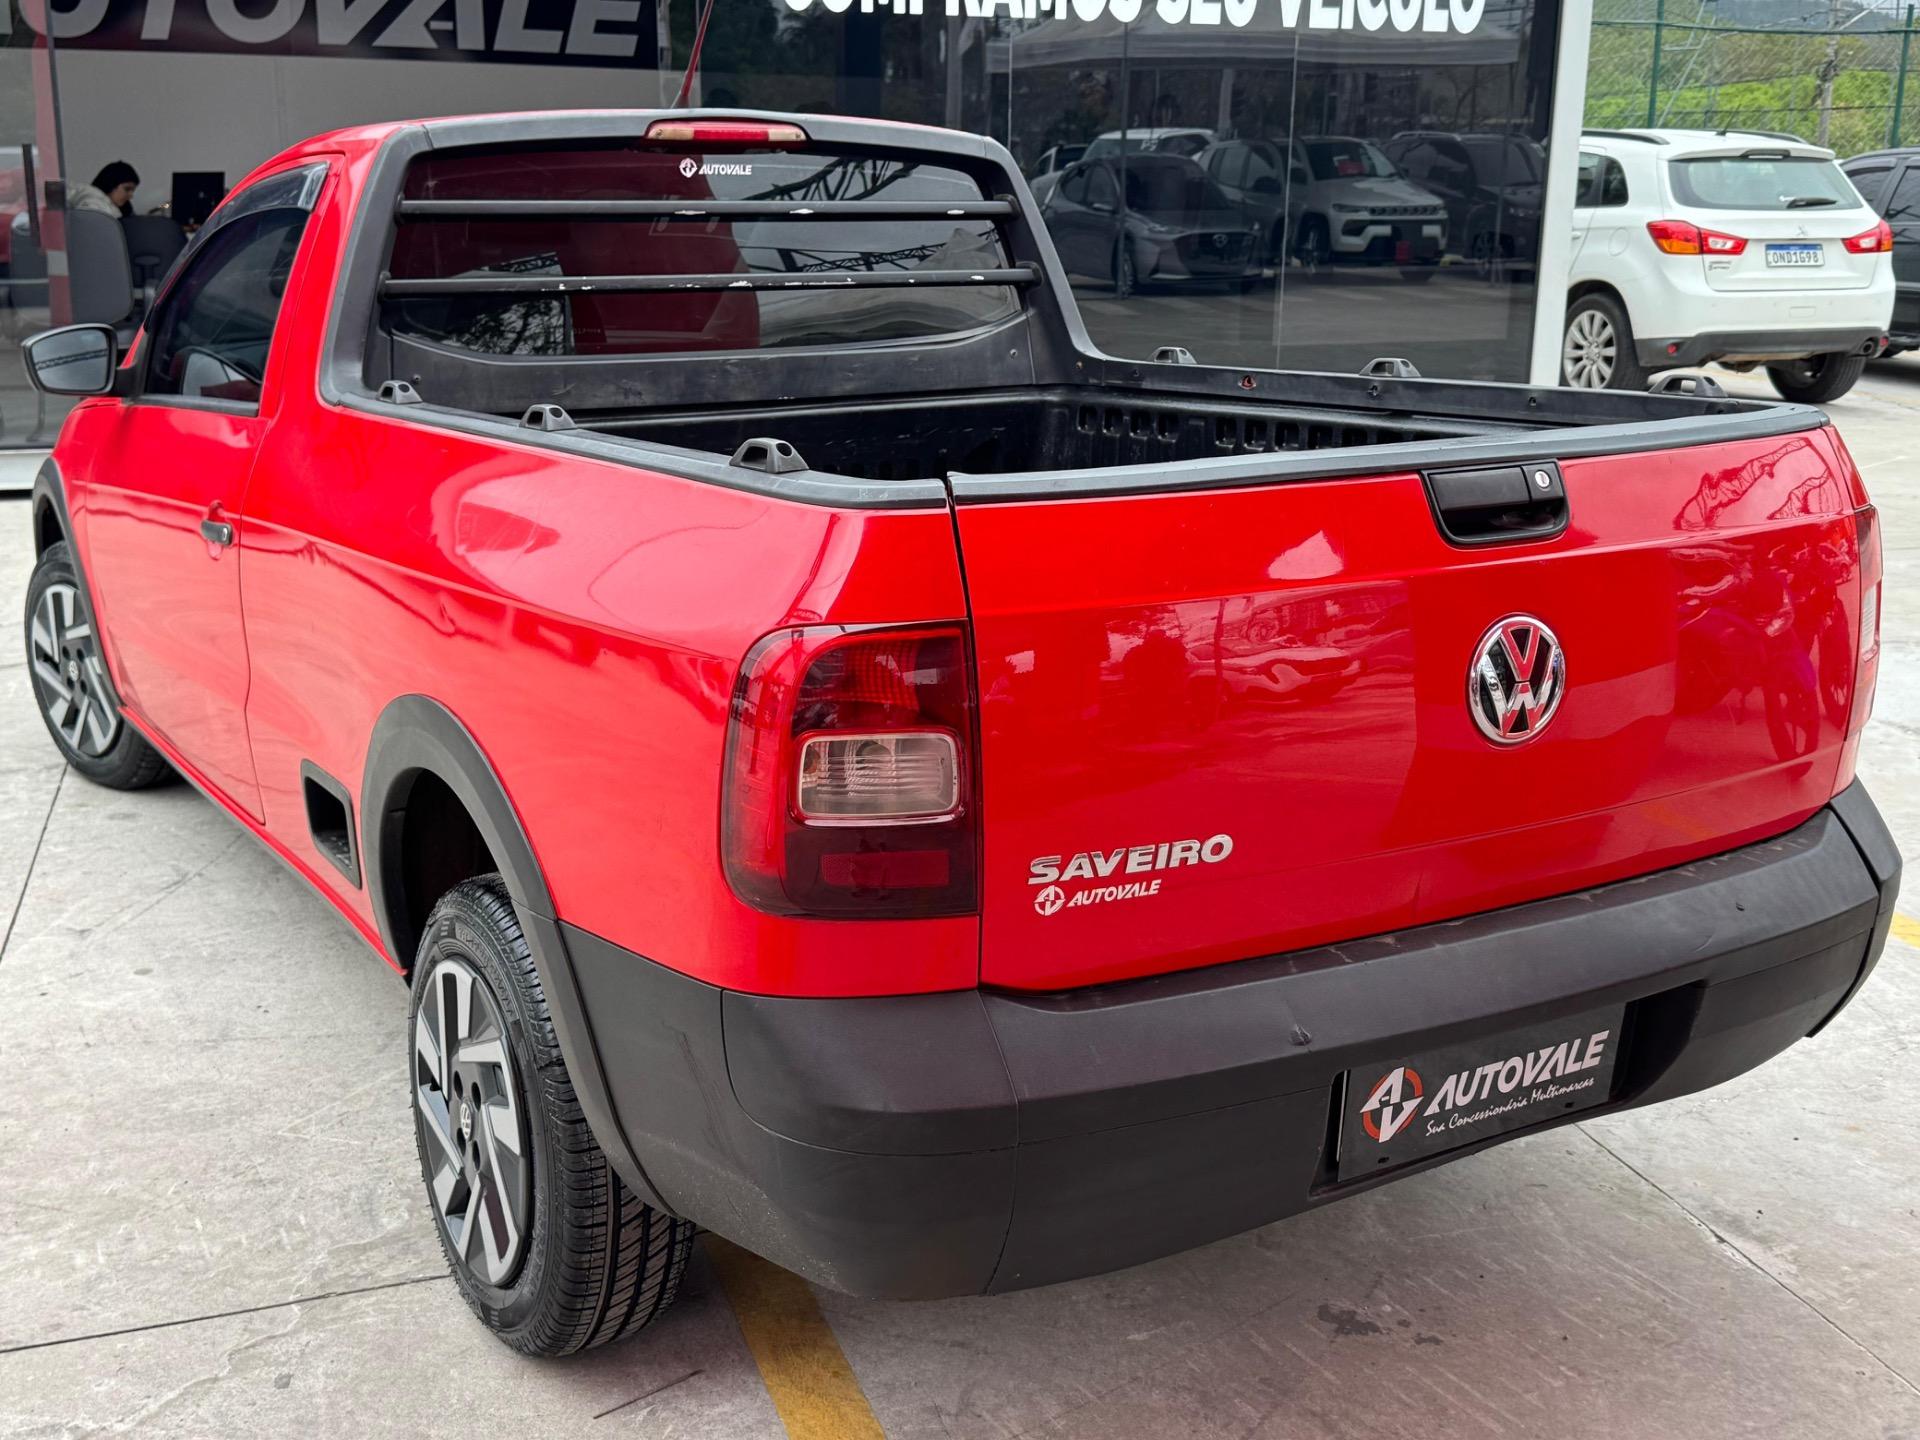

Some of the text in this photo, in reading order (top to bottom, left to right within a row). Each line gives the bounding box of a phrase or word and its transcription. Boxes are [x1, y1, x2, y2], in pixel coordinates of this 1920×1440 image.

[698, 163, 753, 176] AUTOVALE
[1027, 833, 1234, 885] SAVEIRO
[1066, 879, 1162, 908] AUTOVALE
[1422, 1029, 1610, 1117] AUTOVALE
[1425, 1119, 1446, 1137] Sua
[1530, 1077, 1595, 1104] Multimarcas
